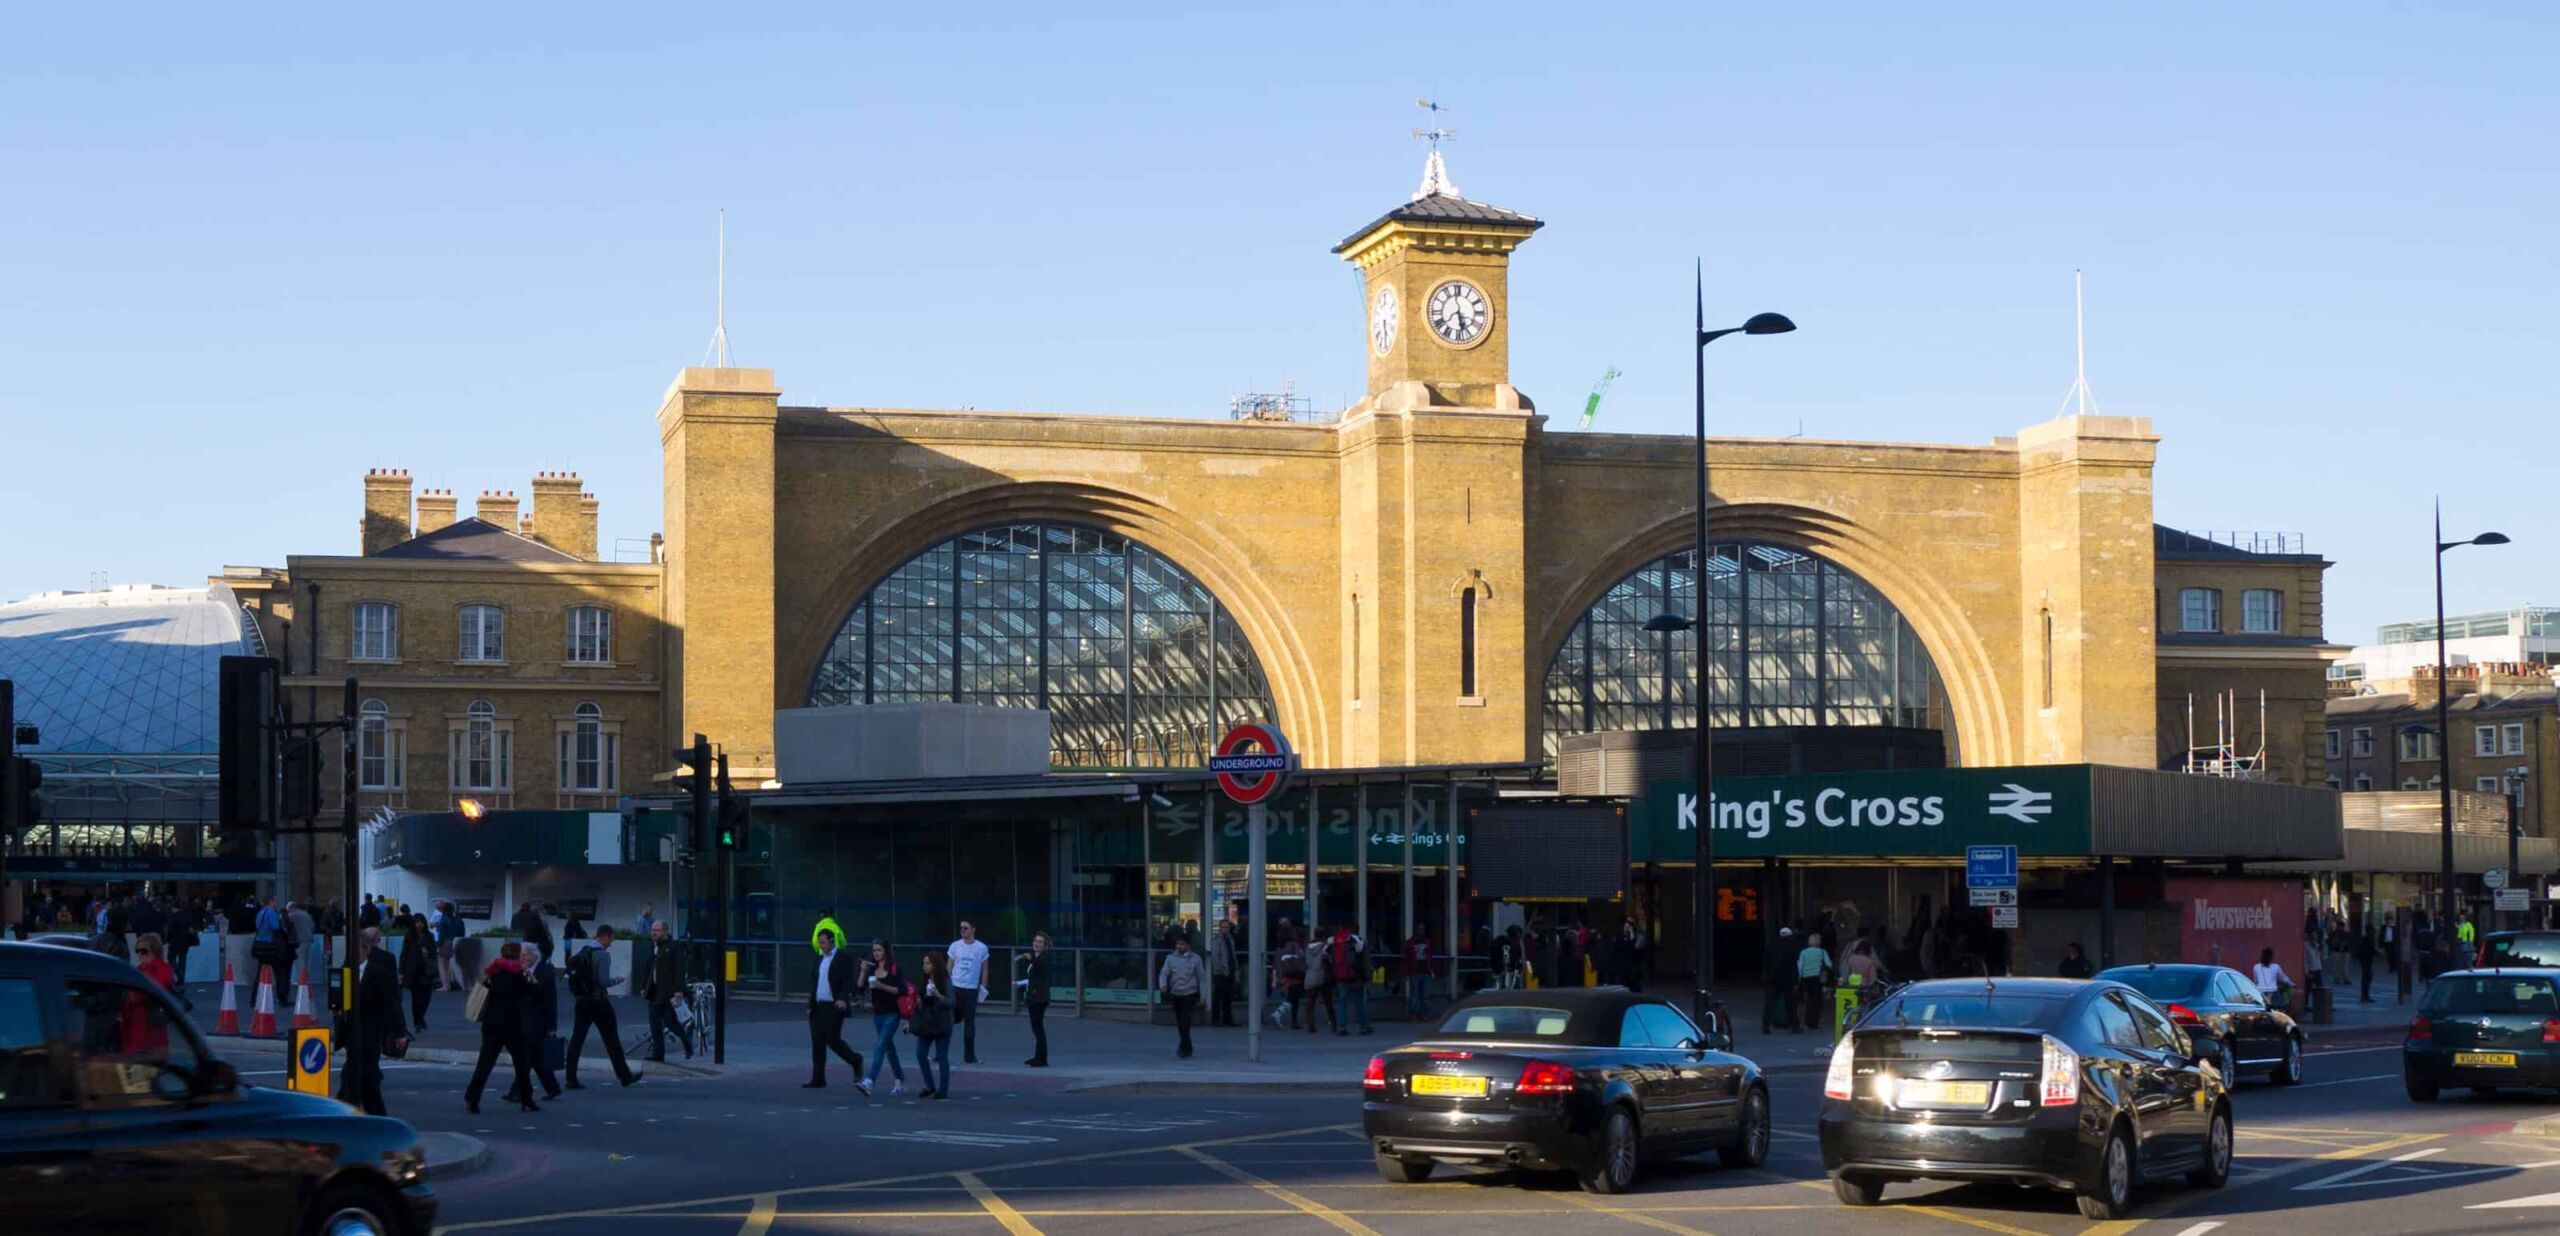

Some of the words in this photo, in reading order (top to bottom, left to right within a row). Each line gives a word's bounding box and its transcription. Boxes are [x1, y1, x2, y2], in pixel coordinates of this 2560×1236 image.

[1211, 757, 1284, 769] UNDERGROUND
[1814, 787, 1944, 828] Cross
[2194, 899, 2273, 930] Newsweek
